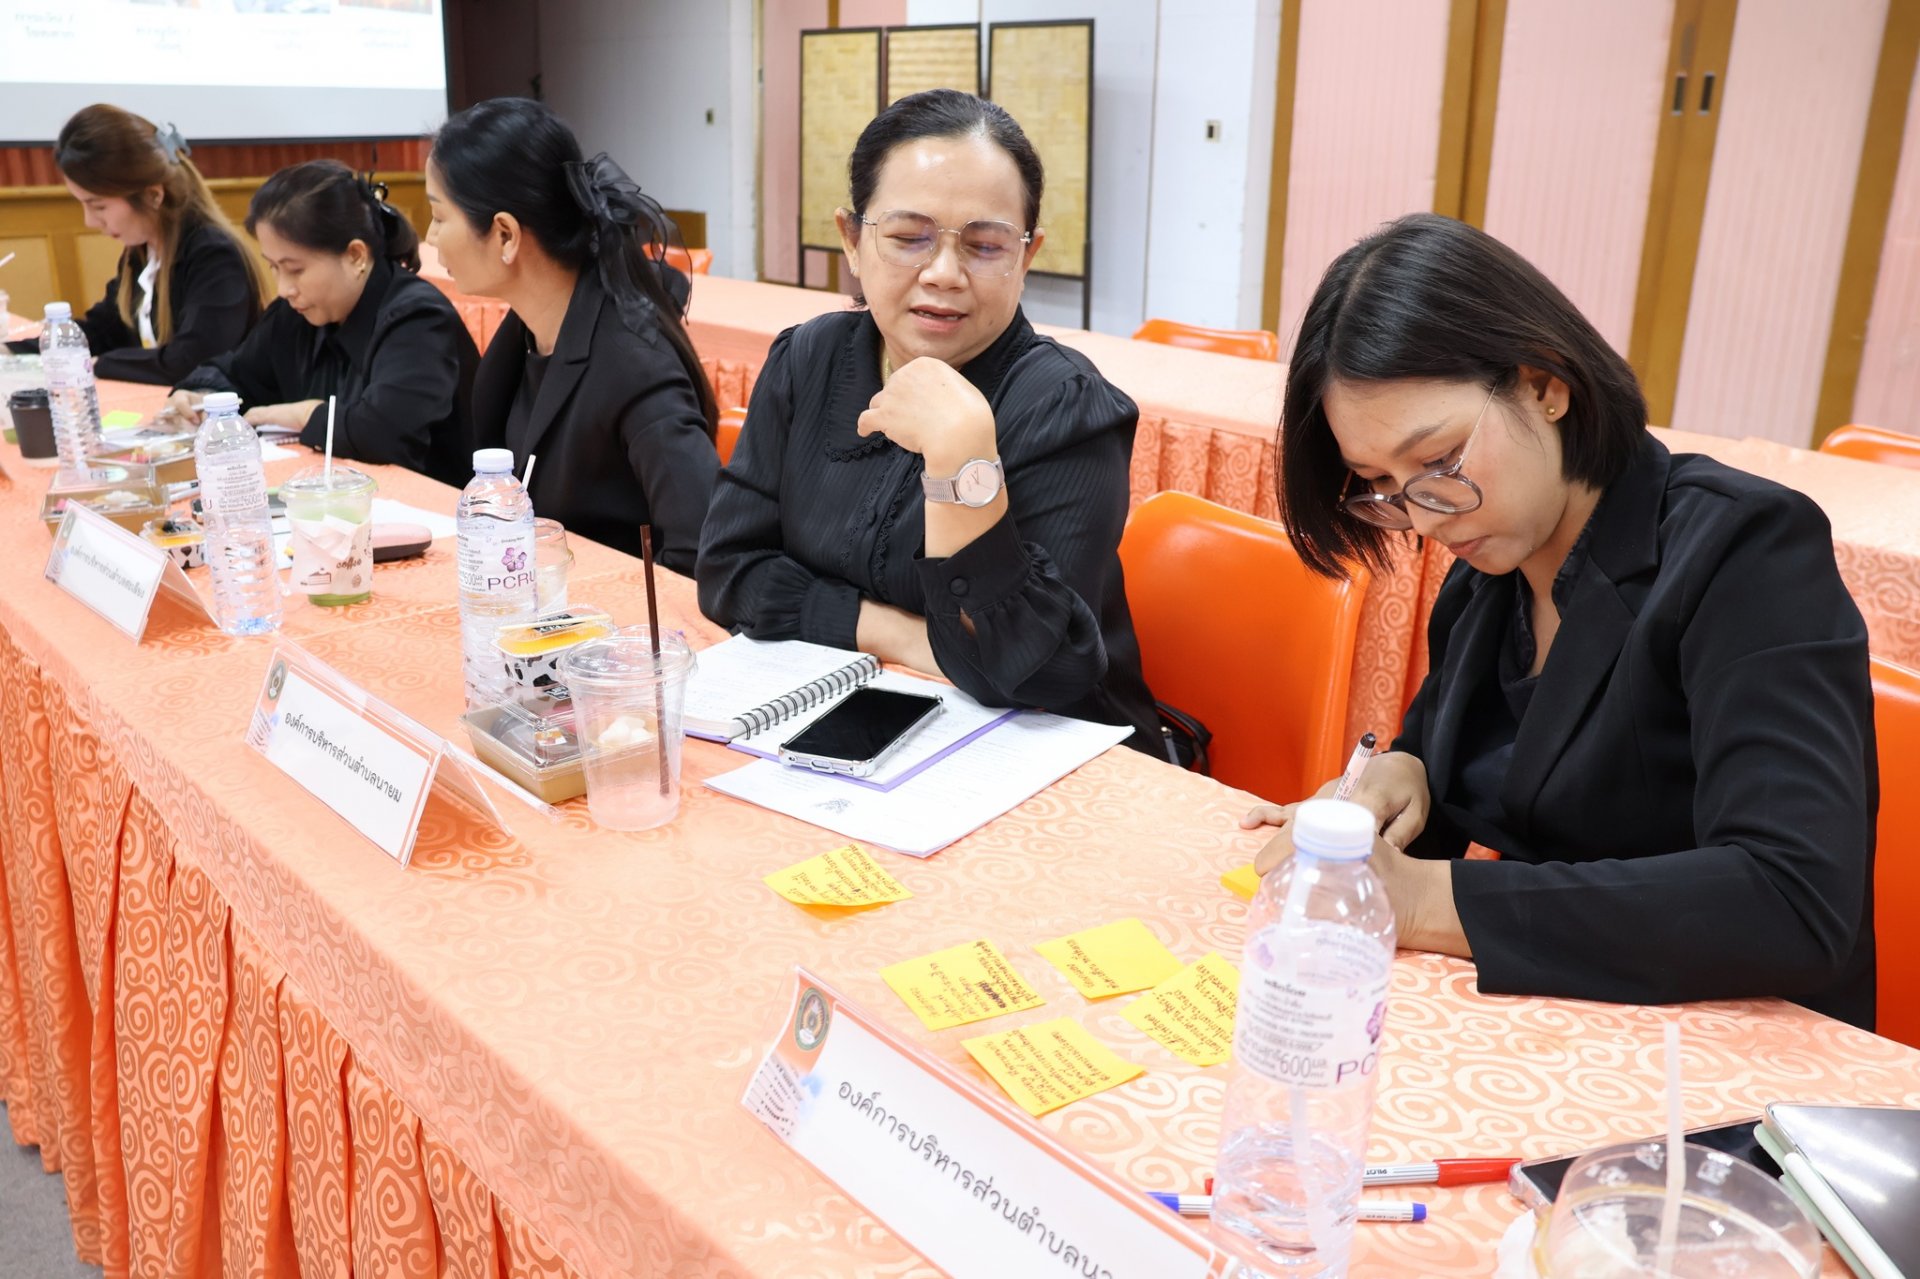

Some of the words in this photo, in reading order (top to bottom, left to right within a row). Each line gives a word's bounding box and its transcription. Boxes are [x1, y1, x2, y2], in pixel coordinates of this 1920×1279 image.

[487, 568, 536, 591] PCRU
[284, 711, 403, 804] องค์การบริหารส่วนตำบลนายม
[1280, 1053, 1312, 1079] 600
